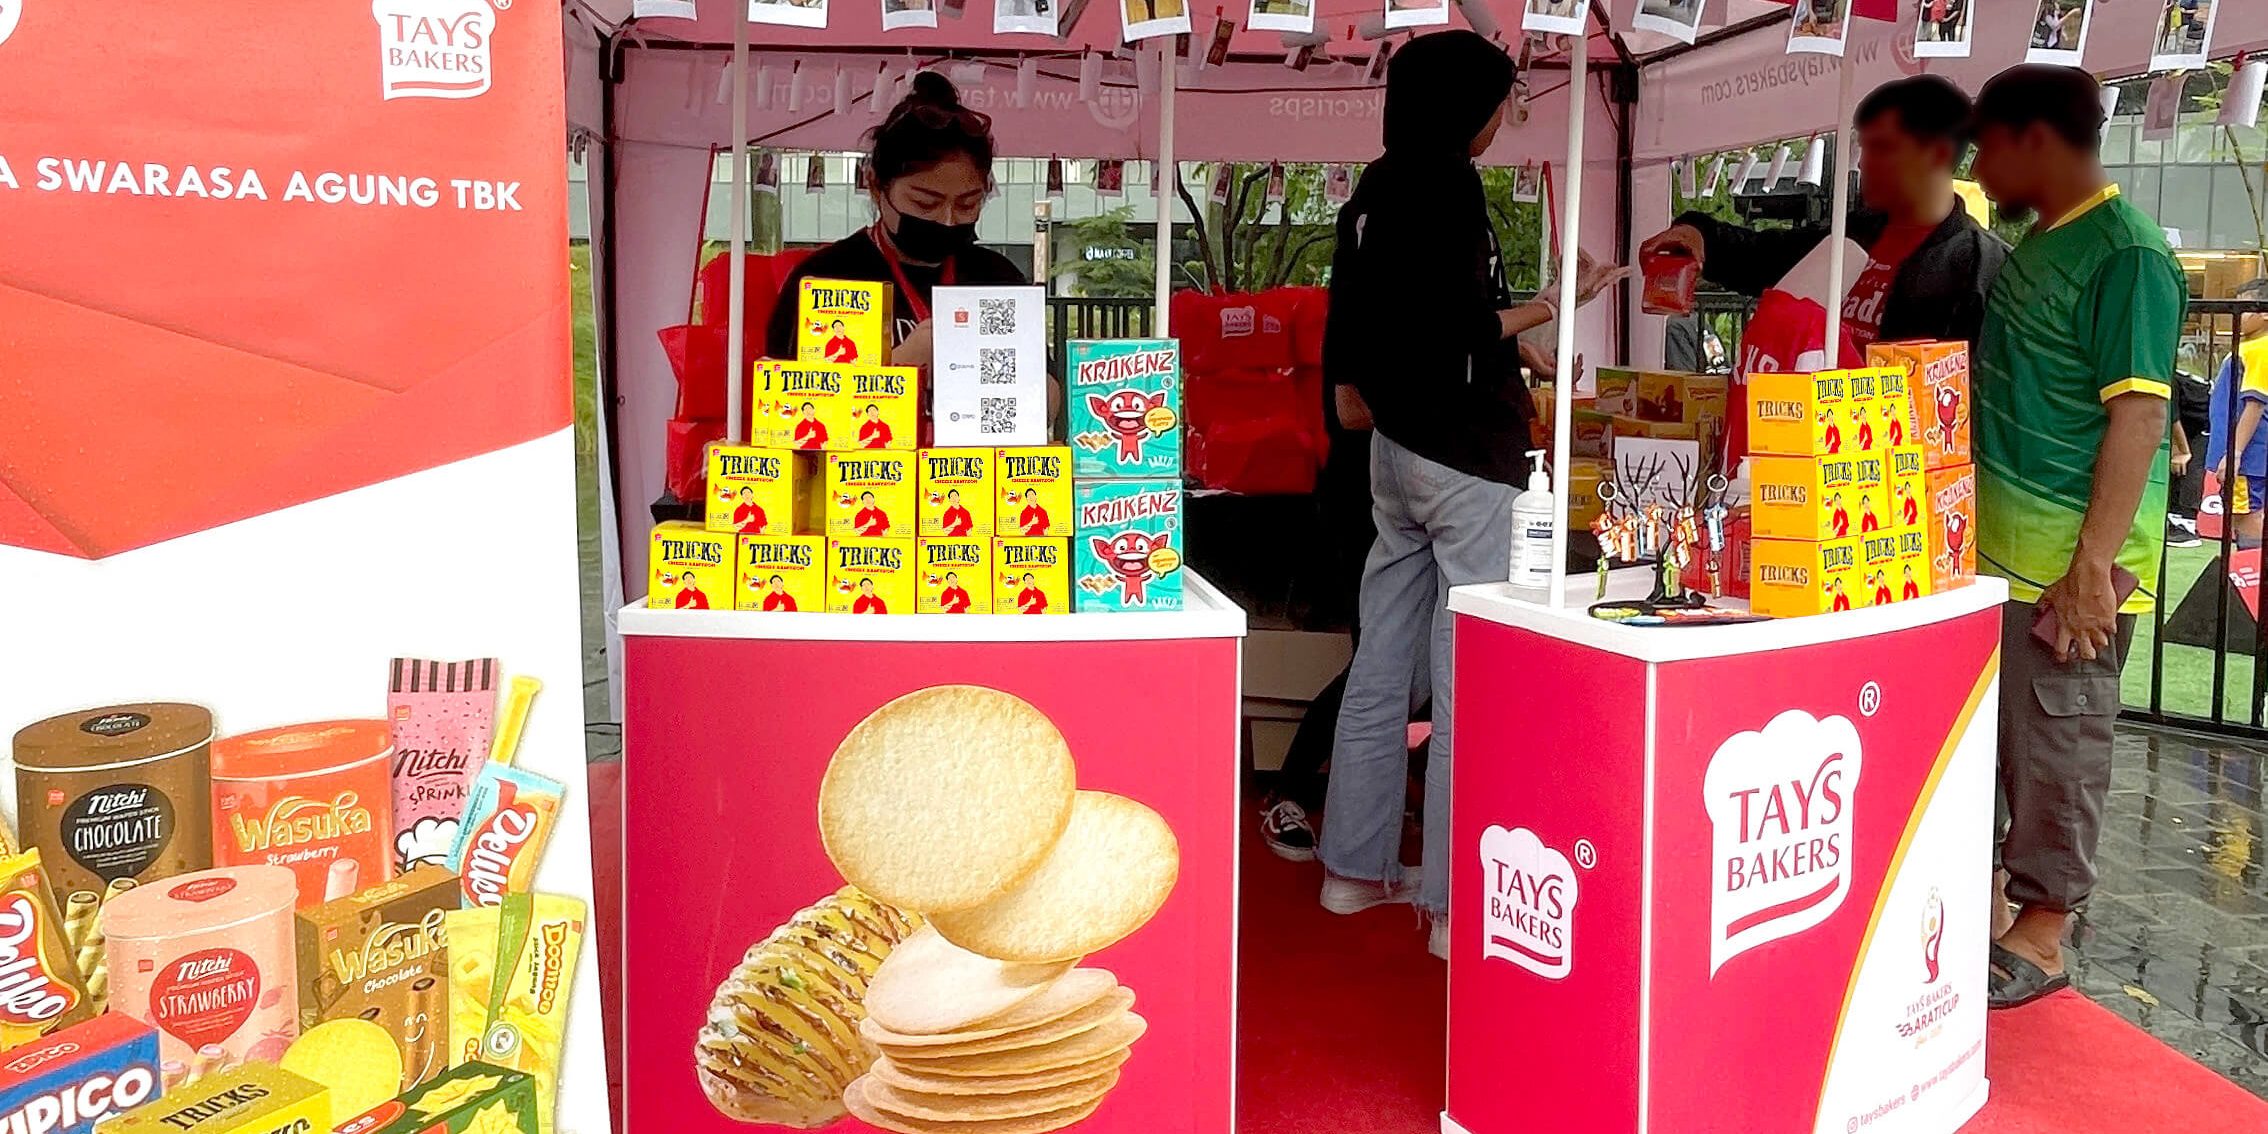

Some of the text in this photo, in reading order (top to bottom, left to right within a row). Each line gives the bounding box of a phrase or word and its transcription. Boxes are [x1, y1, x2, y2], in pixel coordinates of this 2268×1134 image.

[388, 12, 484, 50] TAYS
[390, 48, 484, 75] BAKERS
[36, 157, 268, 201] SWARASA
[282, 171, 440, 209] AGUNG
[451, 179, 522, 211] TBK
[812, 288, 872, 312] TRICKS
[1079, 350, 1175, 385] KRAKENZ
[781, 369, 842, 394] TRICKS
[1817, 379, 1844, 400] TRICKS
[1850, 376, 1875, 399] TRICKS
[1757, 400, 1804, 420] TRICKS
[720, 454, 781, 479] TRICKS
[838, 460, 904, 483] TRICKS
[928, 457, 984, 480] TRICKS
[1005, 455, 1061, 480] TRICKS
[1823, 461, 1852, 485] TRICKS
[1895, 453, 1920, 474] TRICKS
[1760, 484, 1807, 504] TRICKS
[1082, 489, 1177, 527] KRAKENZ
[662, 540, 723, 565] TRICKS
[749, 543, 813, 568] TRICKS
[839, 546, 903, 570] TRICKS
[927, 543, 981, 565] TRICKS
[1003, 544, 1058, 566] TRICKS
[1823, 546, 1853, 570] TRICKS
[1865, 537, 1896, 562] TRICKS
[1760, 565, 1808, 585] TRICKS
[393, 748, 471, 780] Nitchi
[88, 788, 148, 815] Nitchi
[1729, 752, 1844, 844] TAYS
[74, 815, 162, 852] CHOCOLATE
[230, 790, 372, 853] Wasuka
[266, 846, 339, 867] Strawberry
[1726, 833, 1841, 892] BAKERS
[1492, 858, 1564, 920] TAYS
[1490, 896, 1562, 950] BAKERS
[329, 908, 449, 985] Wasuka
[177, 952, 234, 981] Nitchi
[364, 964, 424, 994] Chocolate
[159, 977, 255, 1019] STRAWBERRY
[160, 1082, 271, 1132] TRICKS
